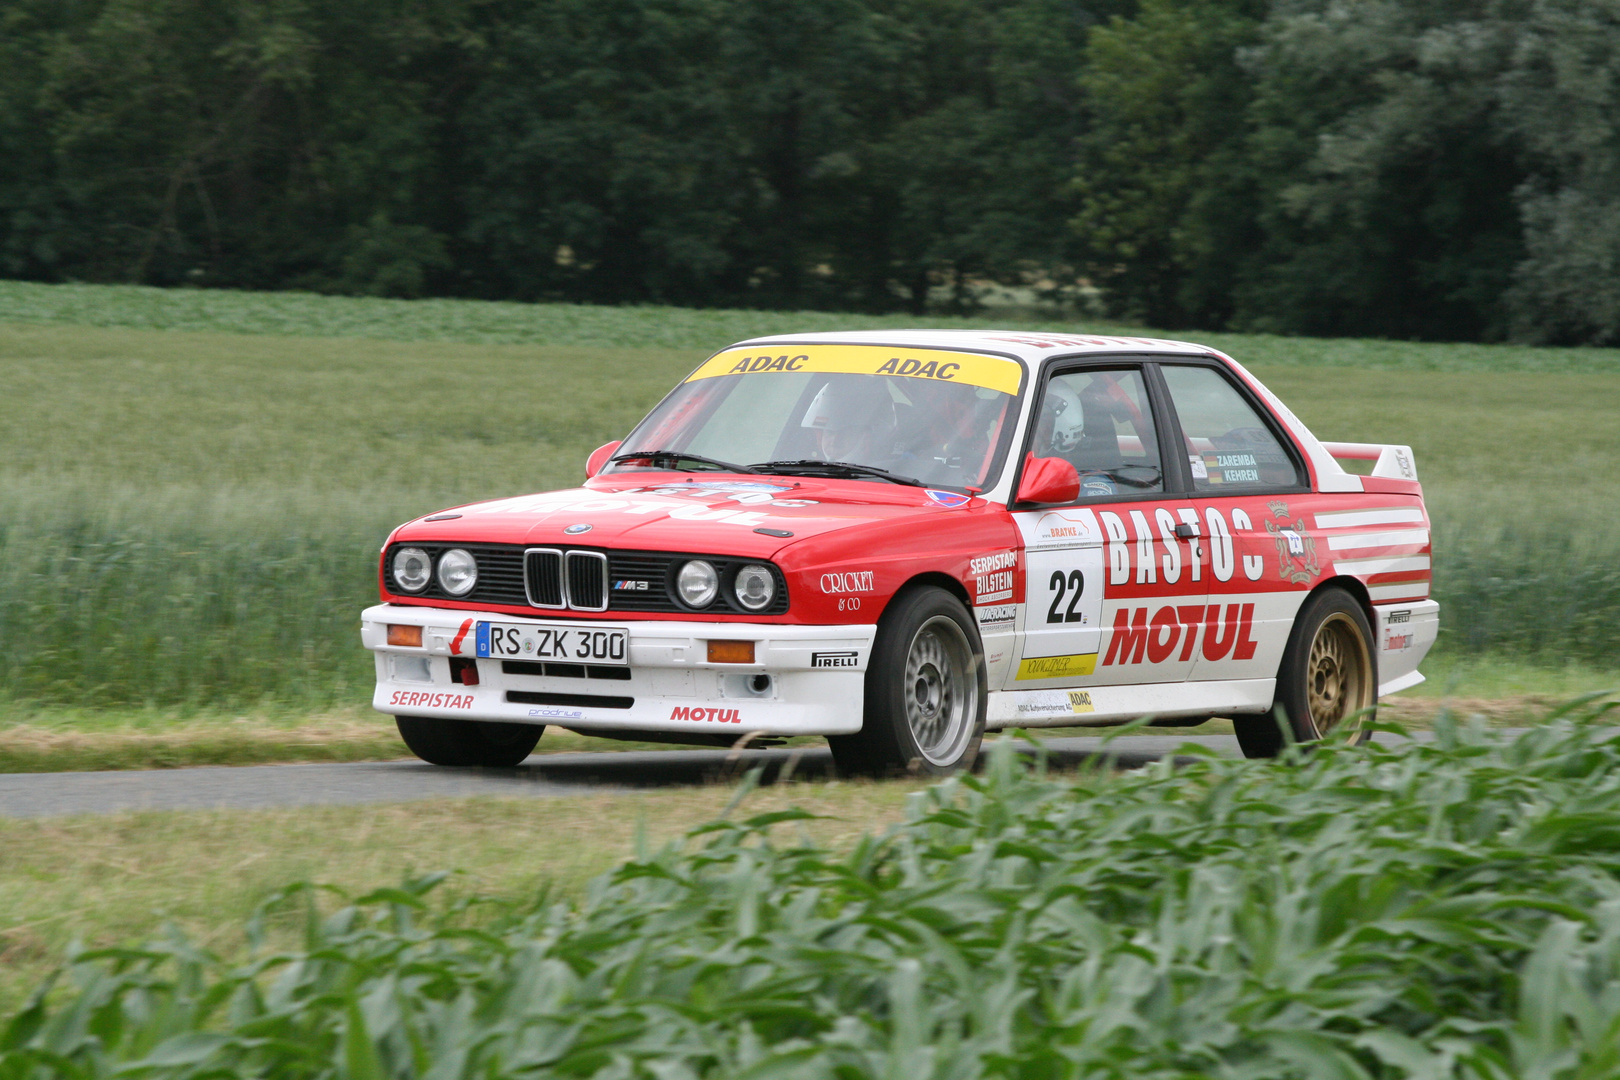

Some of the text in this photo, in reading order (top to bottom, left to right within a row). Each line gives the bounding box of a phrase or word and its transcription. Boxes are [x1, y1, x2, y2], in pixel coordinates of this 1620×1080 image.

[729, 355, 809, 374] ADAC
[875, 358, 960, 379] ADAC
[1217, 455, 1256, 467] ZAREMBA
[1224, 469, 1259, 481] KEHREN
[476, 500, 771, 527] MOTUL
[970, 552, 1016, 575] SERPISTAR
[622, 580, 649, 591] M3
[820, 570, 875, 594] CRICKET
[976, 571, 1012, 594] BILSTEIN
[837, 597, 861, 611] & CO
[1046, 569, 1085, 624] 22
[480, 627, 624, 660] D RS ZK 300
[1102, 603, 1258, 666] MOTUL
[811, 651, 858, 667] PIRELLI
[390, 691, 474, 709] SERPISTAR
[1070, 693, 1092, 706] ADAC
[528, 709, 583, 718] prodrive
[670, 707, 741, 724] MOTUL
